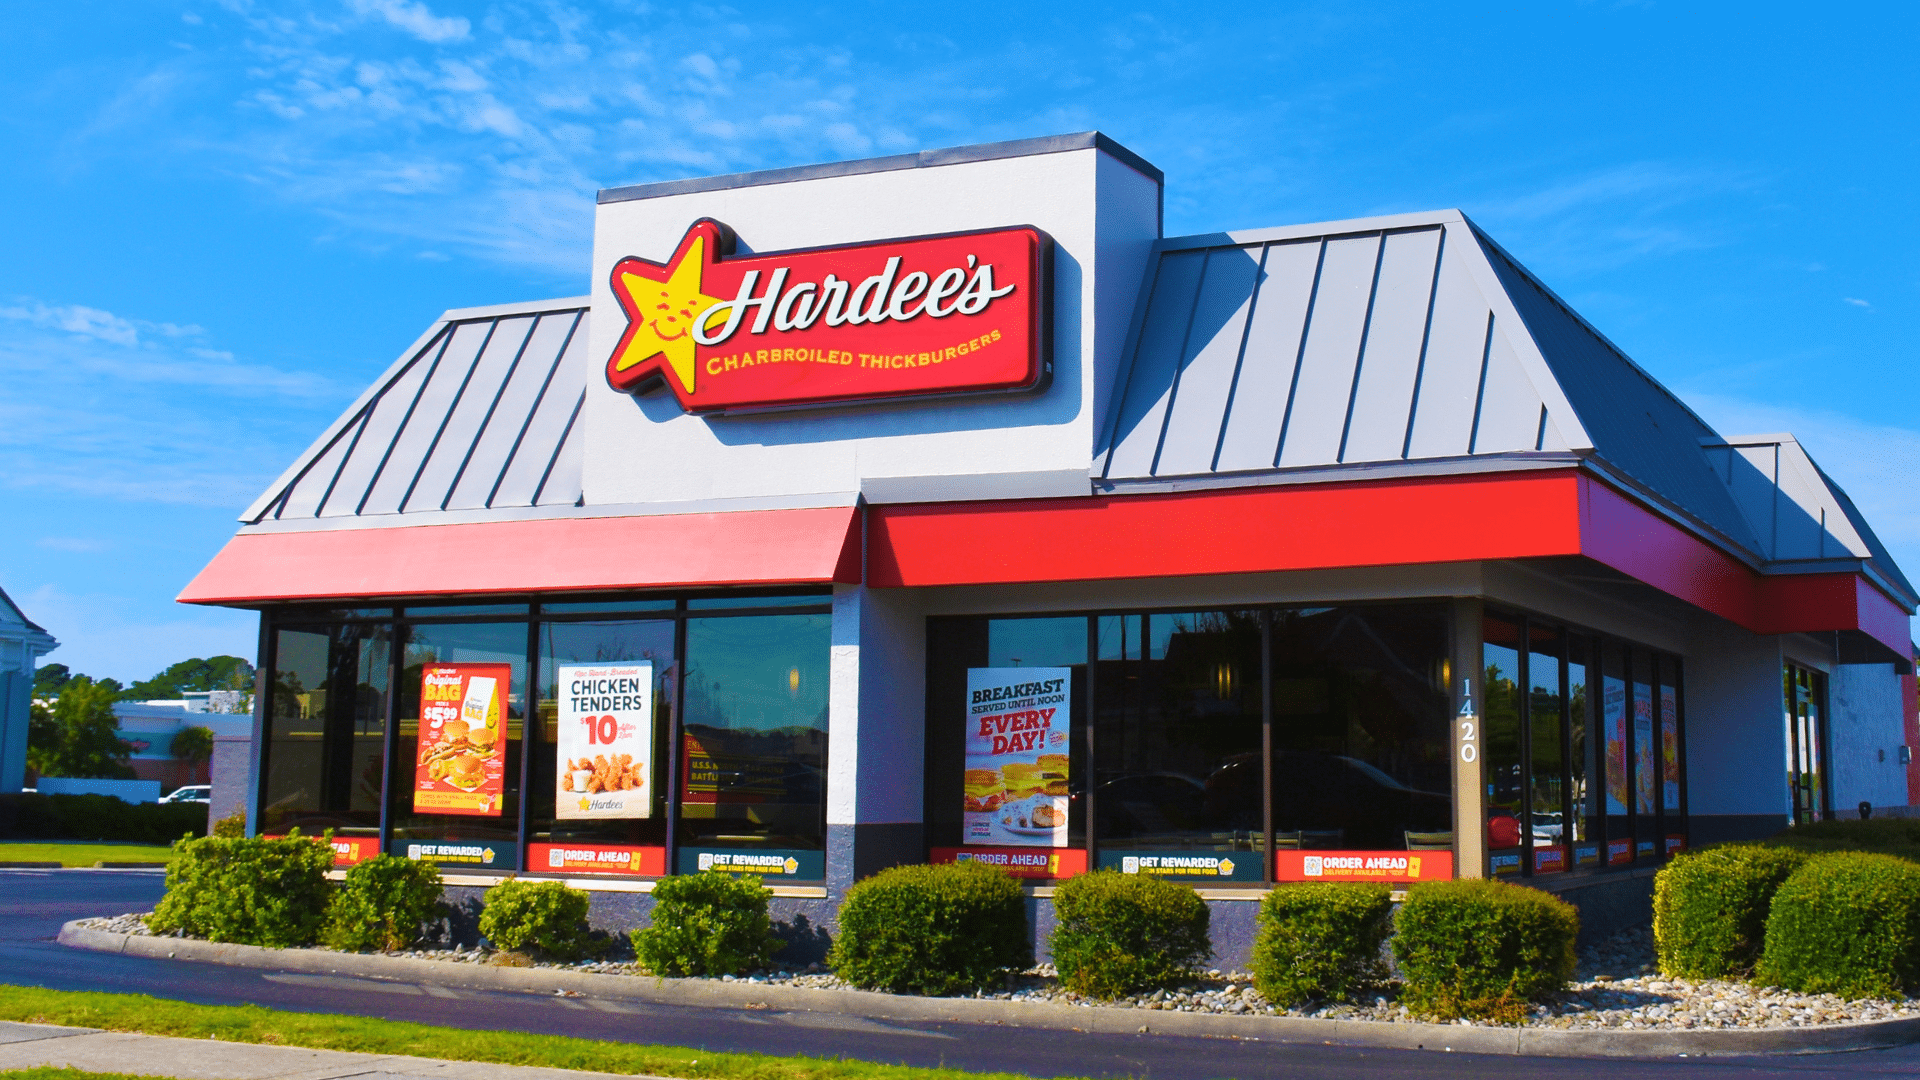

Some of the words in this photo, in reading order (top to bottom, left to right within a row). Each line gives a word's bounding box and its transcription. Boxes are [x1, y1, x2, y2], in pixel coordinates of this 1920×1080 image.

[692, 254, 1015, 346] Hardee's
[706, 348, 853, 376] CHARBROILED
[858, 328, 1002, 369] THICKBURGERS
[424, 673, 462, 687] Original
[571, 678, 639, 694] CHICKEN
[424, 684, 461, 701] BAG
[971, 678, 1065, 704] BREAKFAST
[571, 695, 642, 712] TENDERS
[971, 702, 1006, 714] SERVED
[1008, 697, 1036, 709] UNTIL
[1037, 694, 1065, 706] NOON
[979, 708, 1056, 736] EVERY
[992, 730, 1045, 755] DAY!
[421, 845, 437, 855] GET
[438, 845, 483, 856] REWARDED
[564, 850, 596, 861] ORDER
[597, 851, 631, 863] AHEAD
[714, 854, 731, 865] GET
[732, 854, 784, 866] REWARDED
[1010, 854, 1048, 866] AHEAD
[1139, 857, 1159, 867] GET
[1161, 857, 1219, 868] REWARDED
[1323, 857, 1363, 868] ORDER
[1365, 857, 1407, 869] AHEAD
